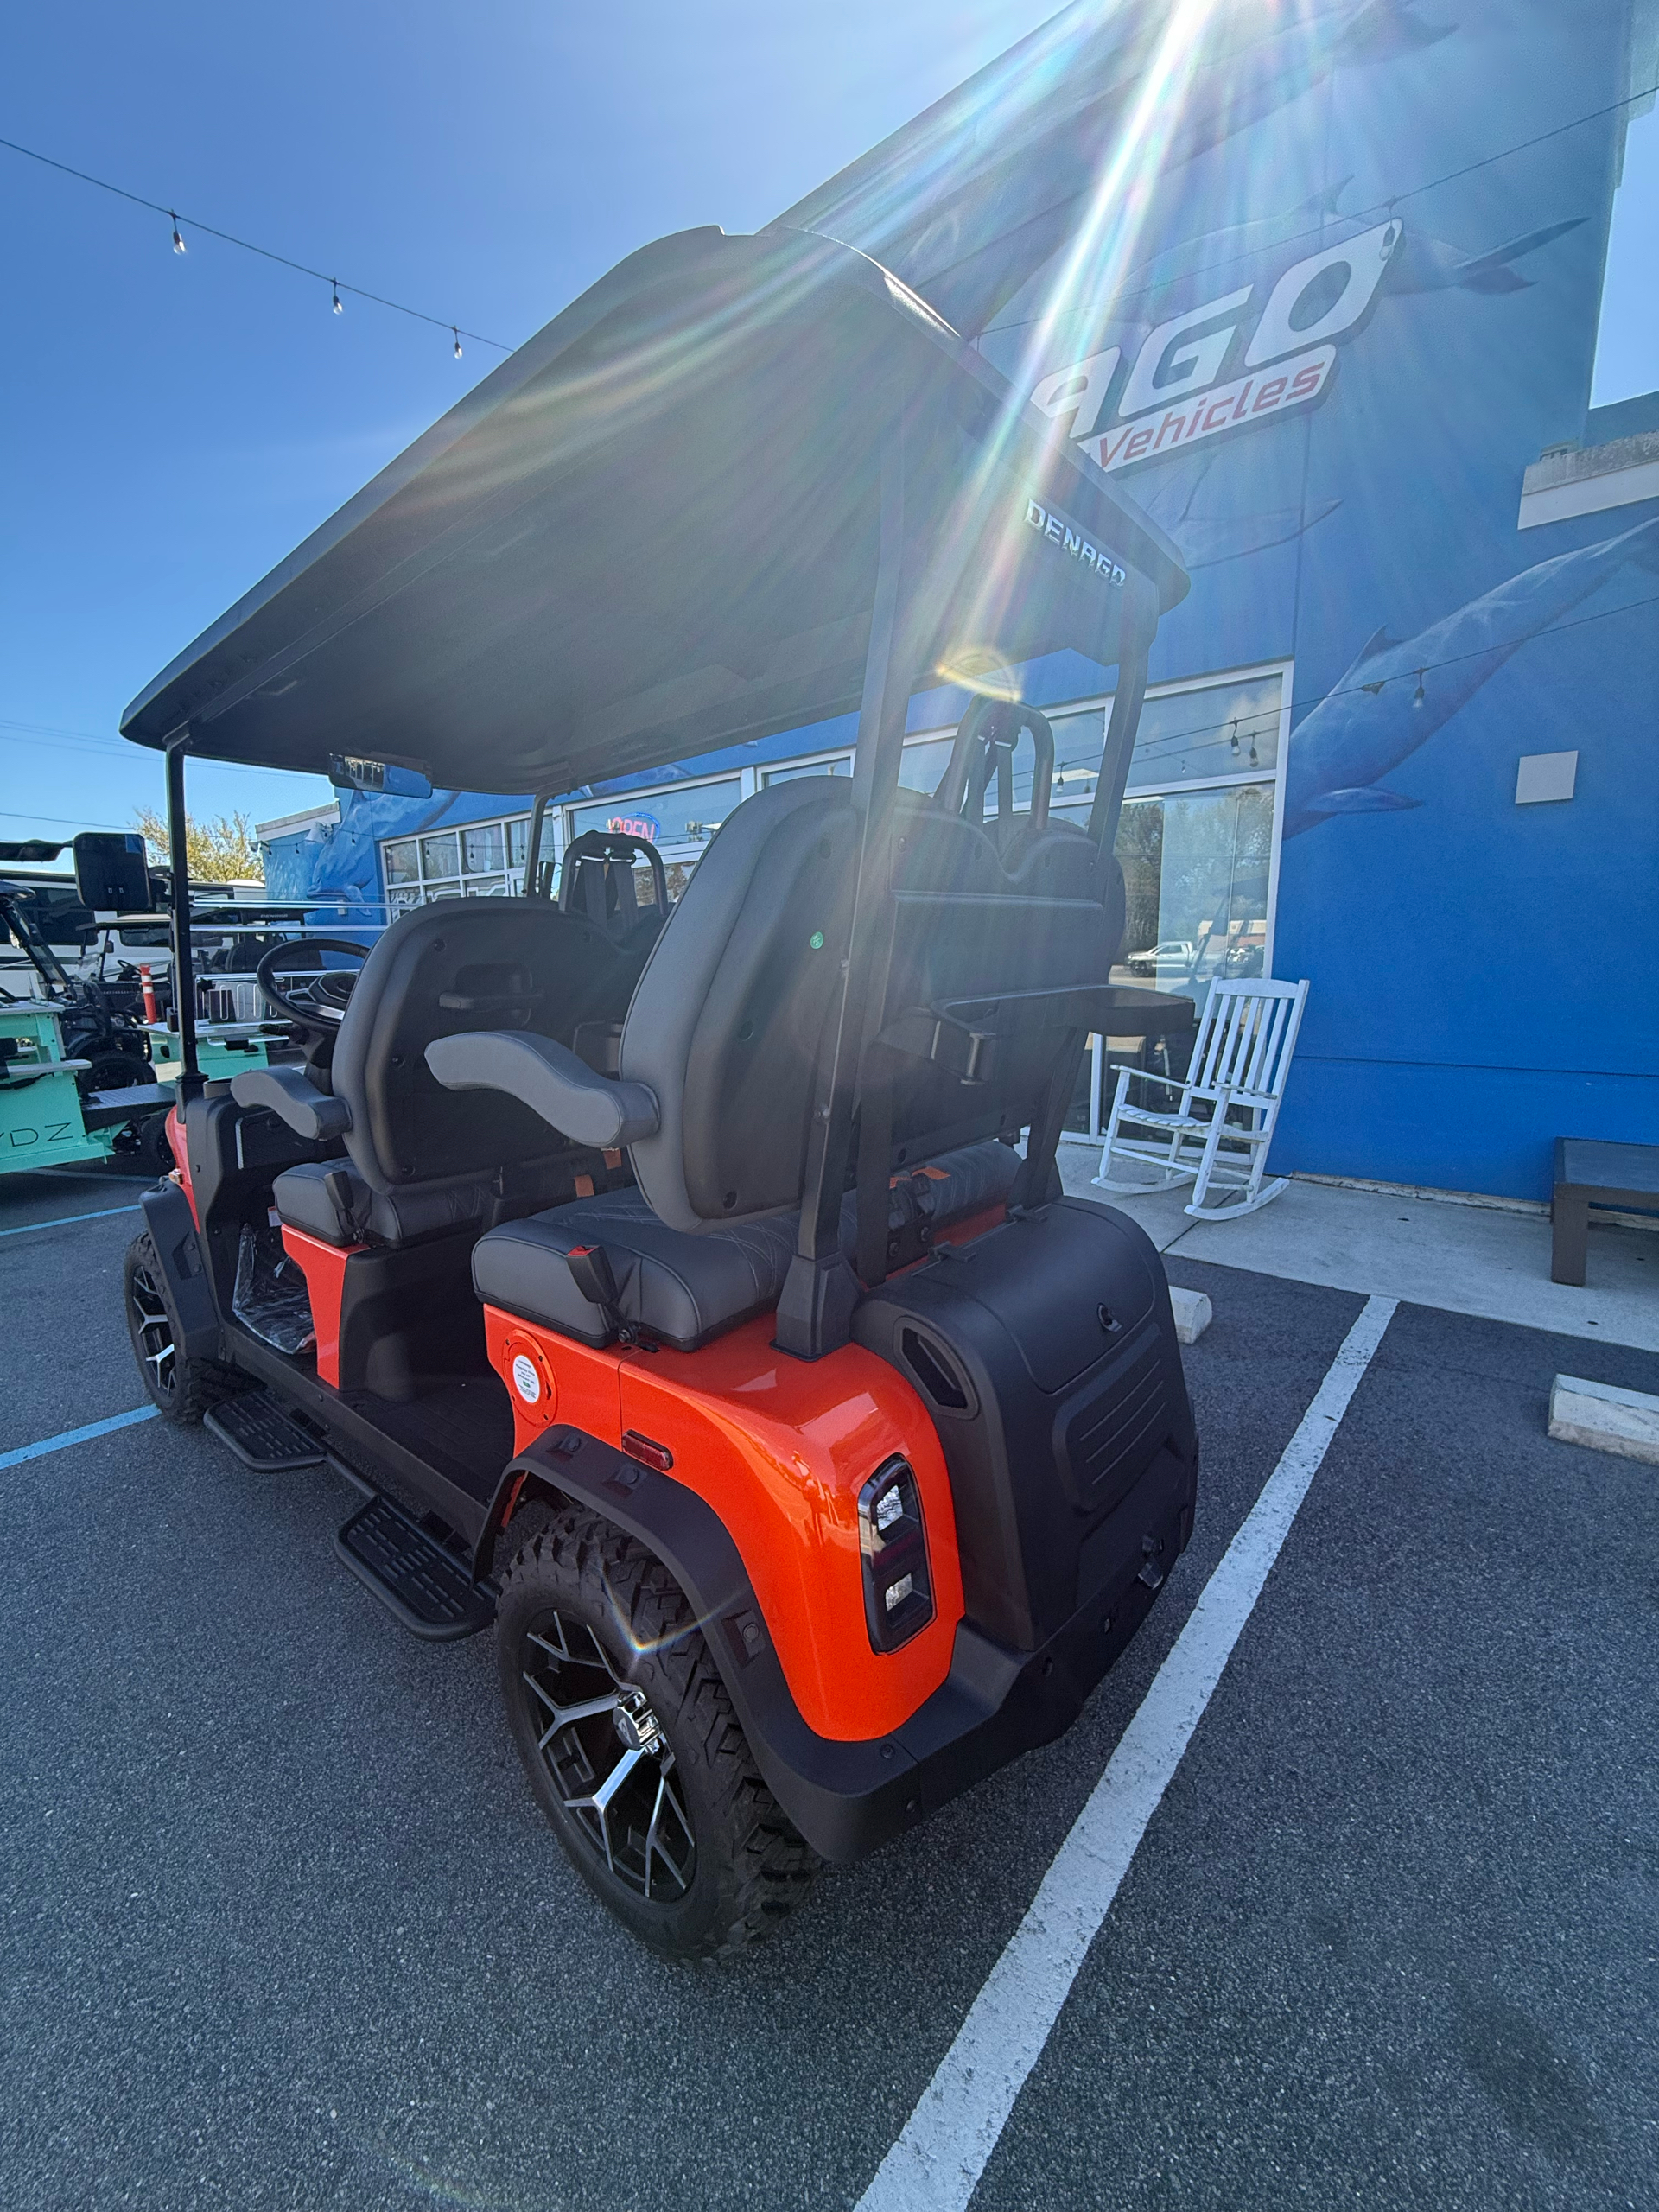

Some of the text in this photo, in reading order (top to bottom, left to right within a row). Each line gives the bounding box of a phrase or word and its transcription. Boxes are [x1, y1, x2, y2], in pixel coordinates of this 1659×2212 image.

[1099, 360, 1325, 468] Vehicles
[1023, 498, 1126, 587] DENAGO
[610, 817, 655, 843] OPEN
[0, 1122, 74, 1147] DZ
